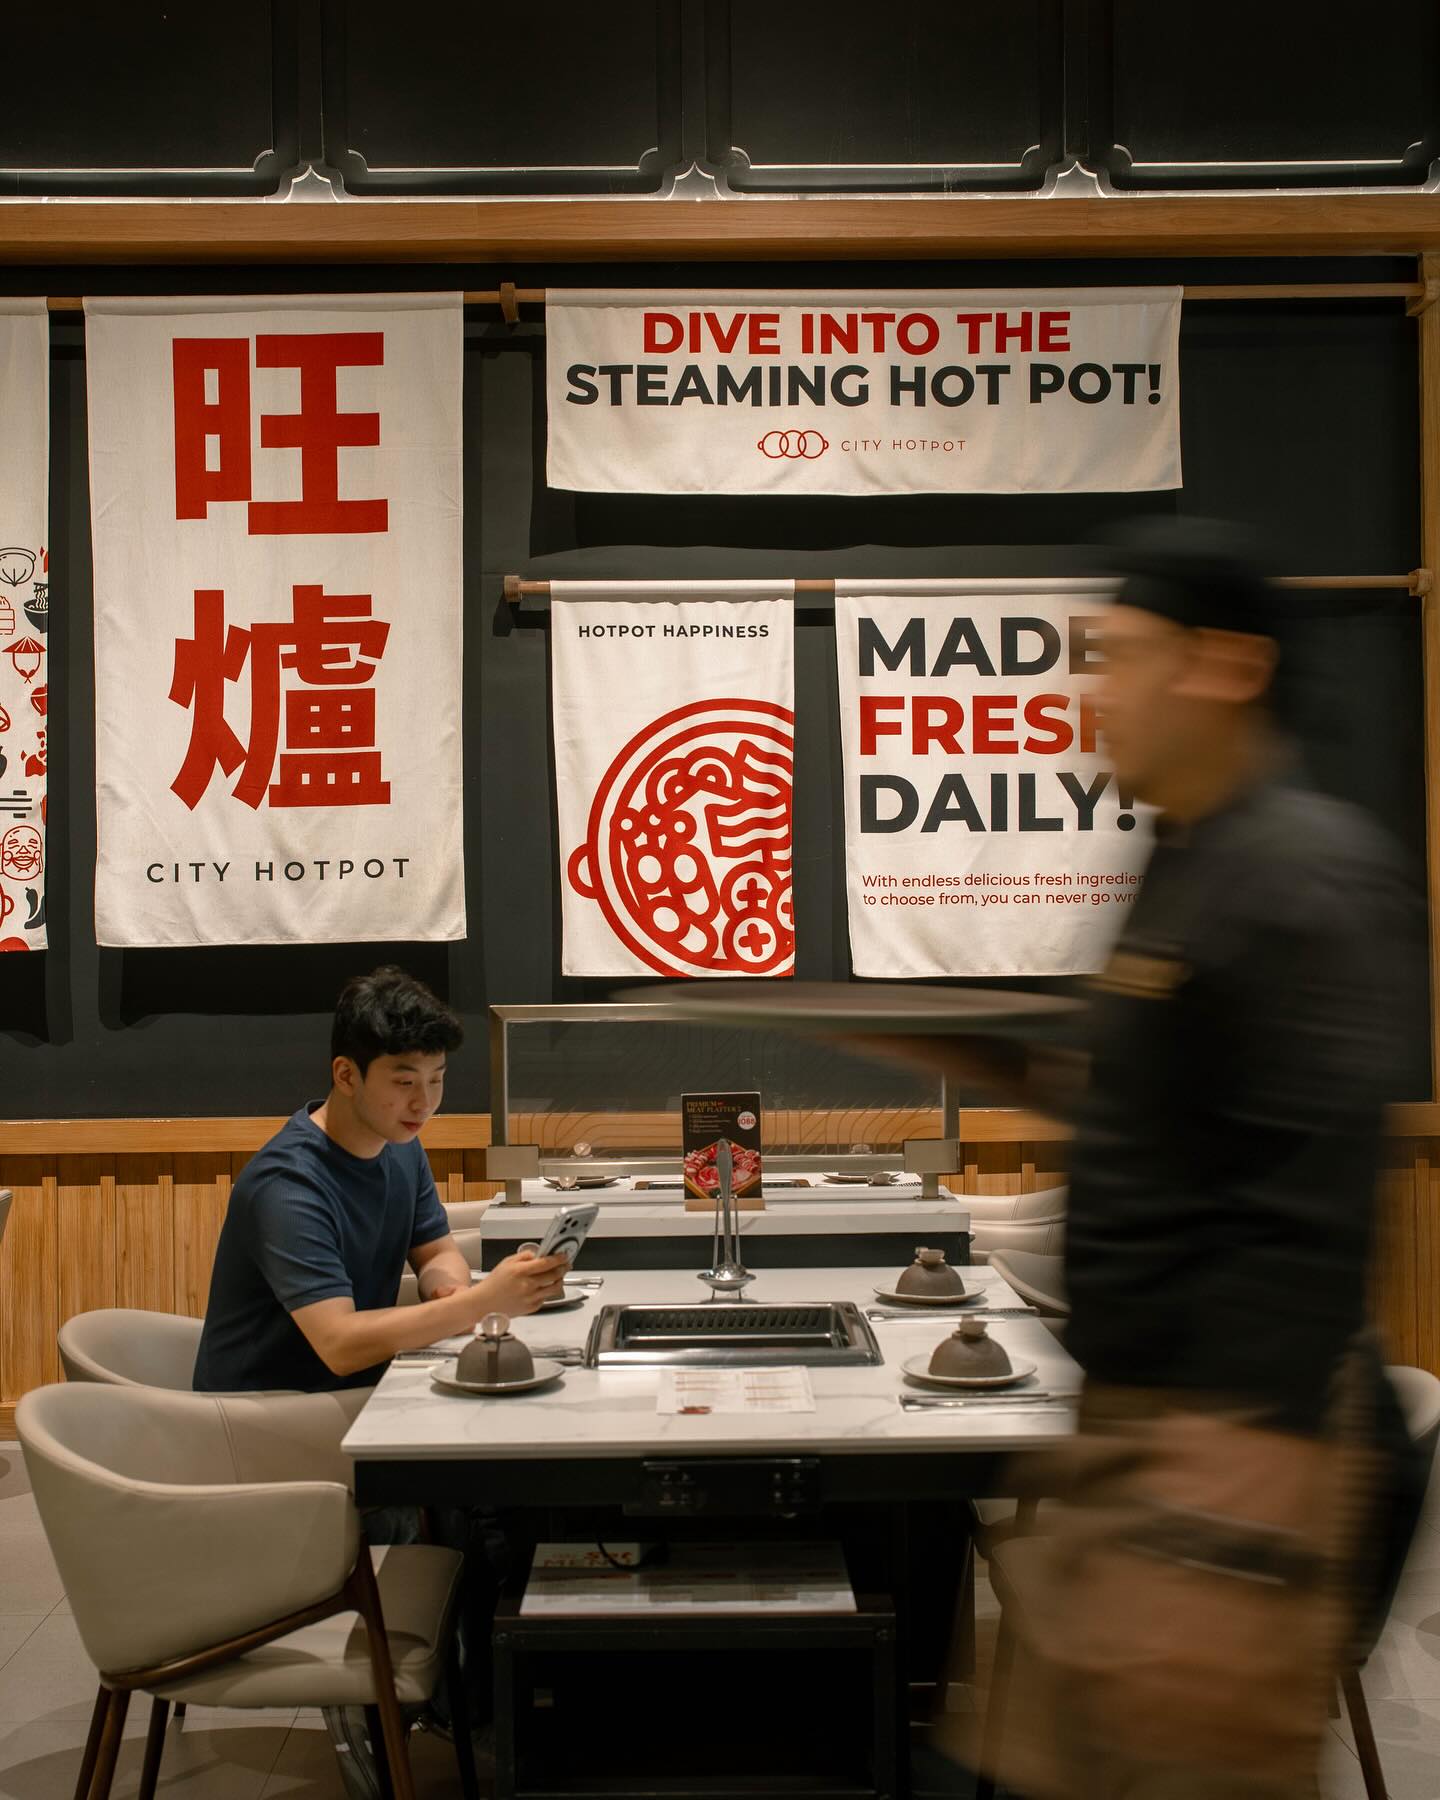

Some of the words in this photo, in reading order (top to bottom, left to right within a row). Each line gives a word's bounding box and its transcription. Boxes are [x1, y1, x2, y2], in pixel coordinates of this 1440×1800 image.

[642, 311, 781, 355] DIVE
[801, 312, 940, 356] INTO
[957, 311, 1071, 354] THE
[565, 363, 870, 408] STEAMING
[889, 363, 1012, 408] HOT
[1028, 362, 1163, 406] POT!
[840, 439, 882, 452] CITY
[892, 439, 967, 452] HOTPOT
[168, 332, 391, 811] 旺爐
[578, 624, 656, 639] HOTPOT
[663, 624, 770, 639] HAPPINESS
[857, 615, 1110, 677] MADE
[859, 771, 1137, 834] DAILY!
[146, 861, 231, 884] CITY
[255, 857, 411, 883] HOTPOT
[861, 873, 898, 888] With
[901, 873, 961, 888] endless
[964, 872, 1031, 887] delicious
[1033, 872, 1073, 886] fresh
[862, 894, 877, 906] to
[880, 892, 936, 906] choose
[938, 892, 979, 908] from,
[980, 894, 1009, 907] you
[1012, 894, 1041, 905] can
[1045, 893, 1088, 904] never
[1090, 892, 1111, 906] go
